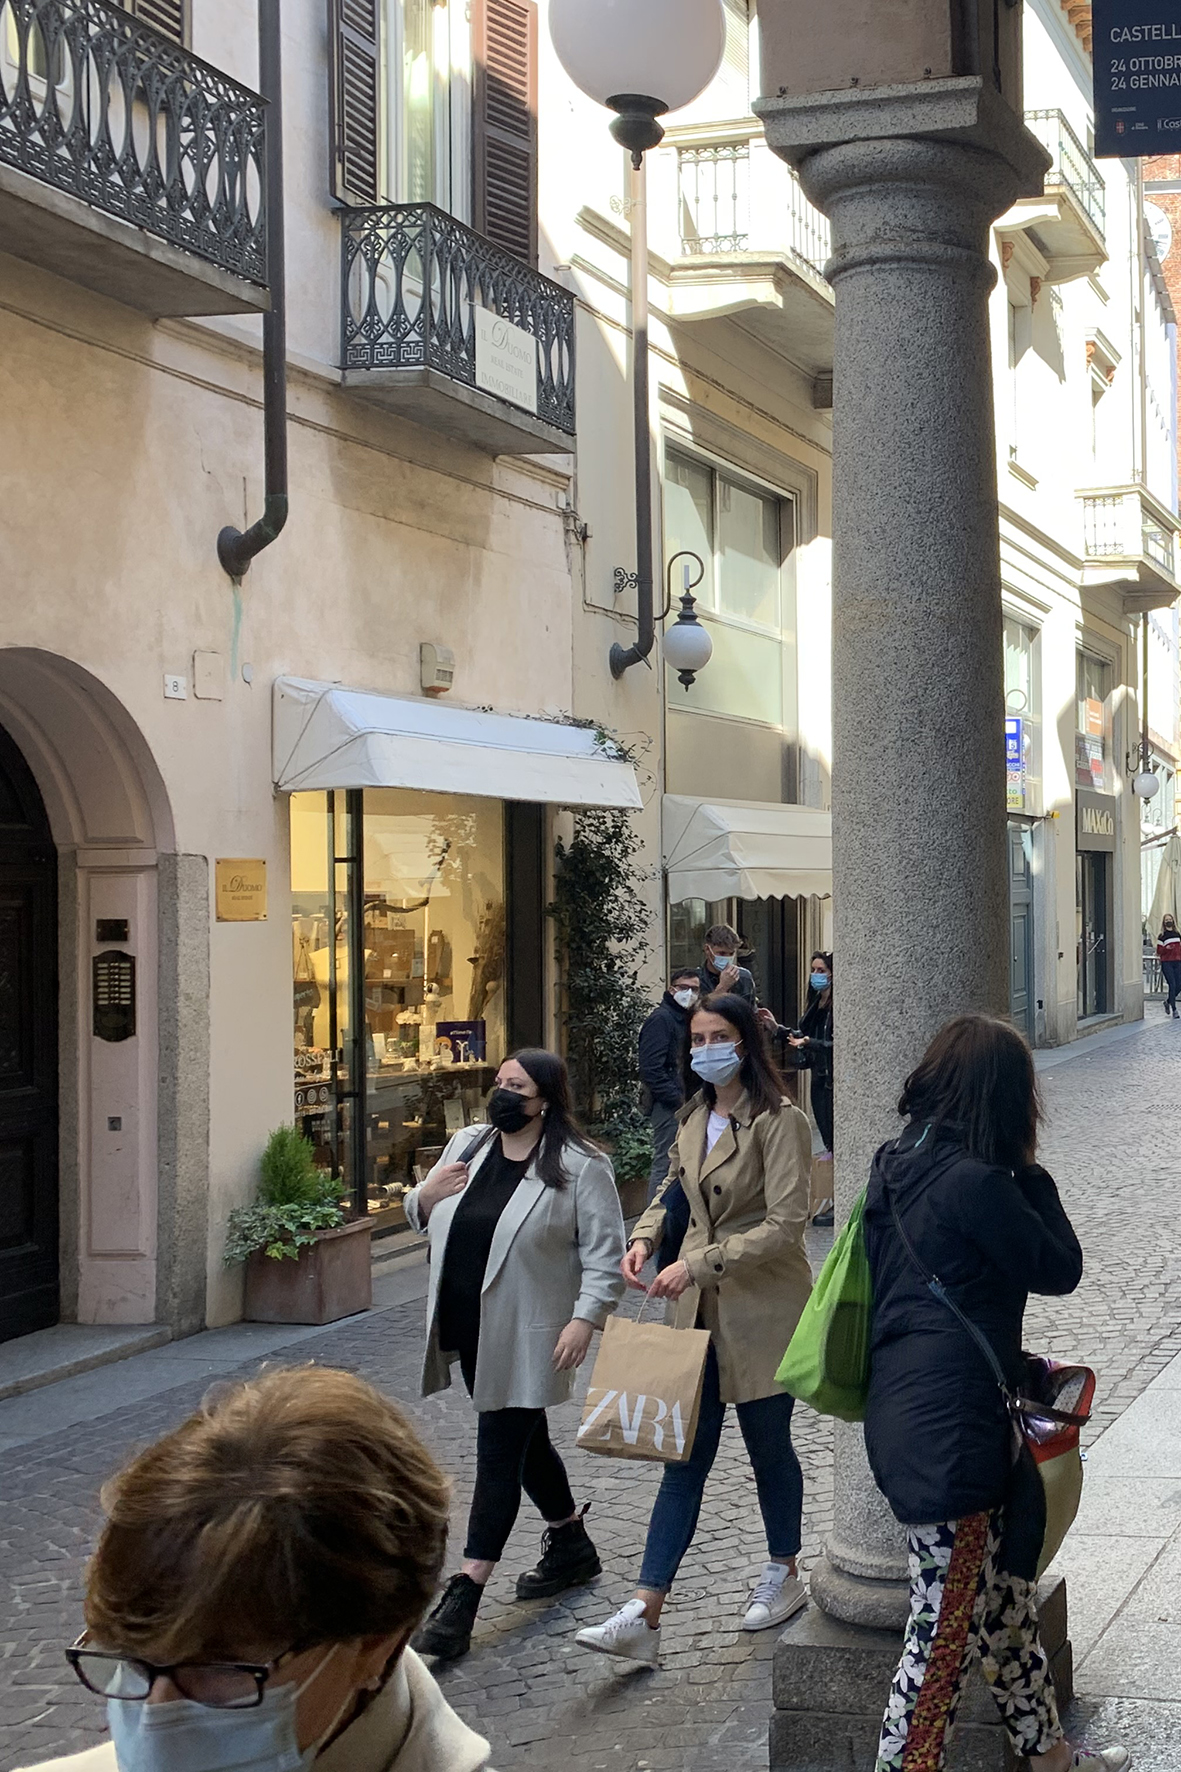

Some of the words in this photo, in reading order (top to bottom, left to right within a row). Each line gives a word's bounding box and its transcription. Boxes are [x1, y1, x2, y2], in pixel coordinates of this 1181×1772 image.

[1110, 59, 1126, 73] 24
[1111, 77, 1127, 90] 24
[481, 372, 533, 406] IMMOBILIARE
[172, 680, 179, 692] 8
[577, 1388, 686, 1454] ZARA
